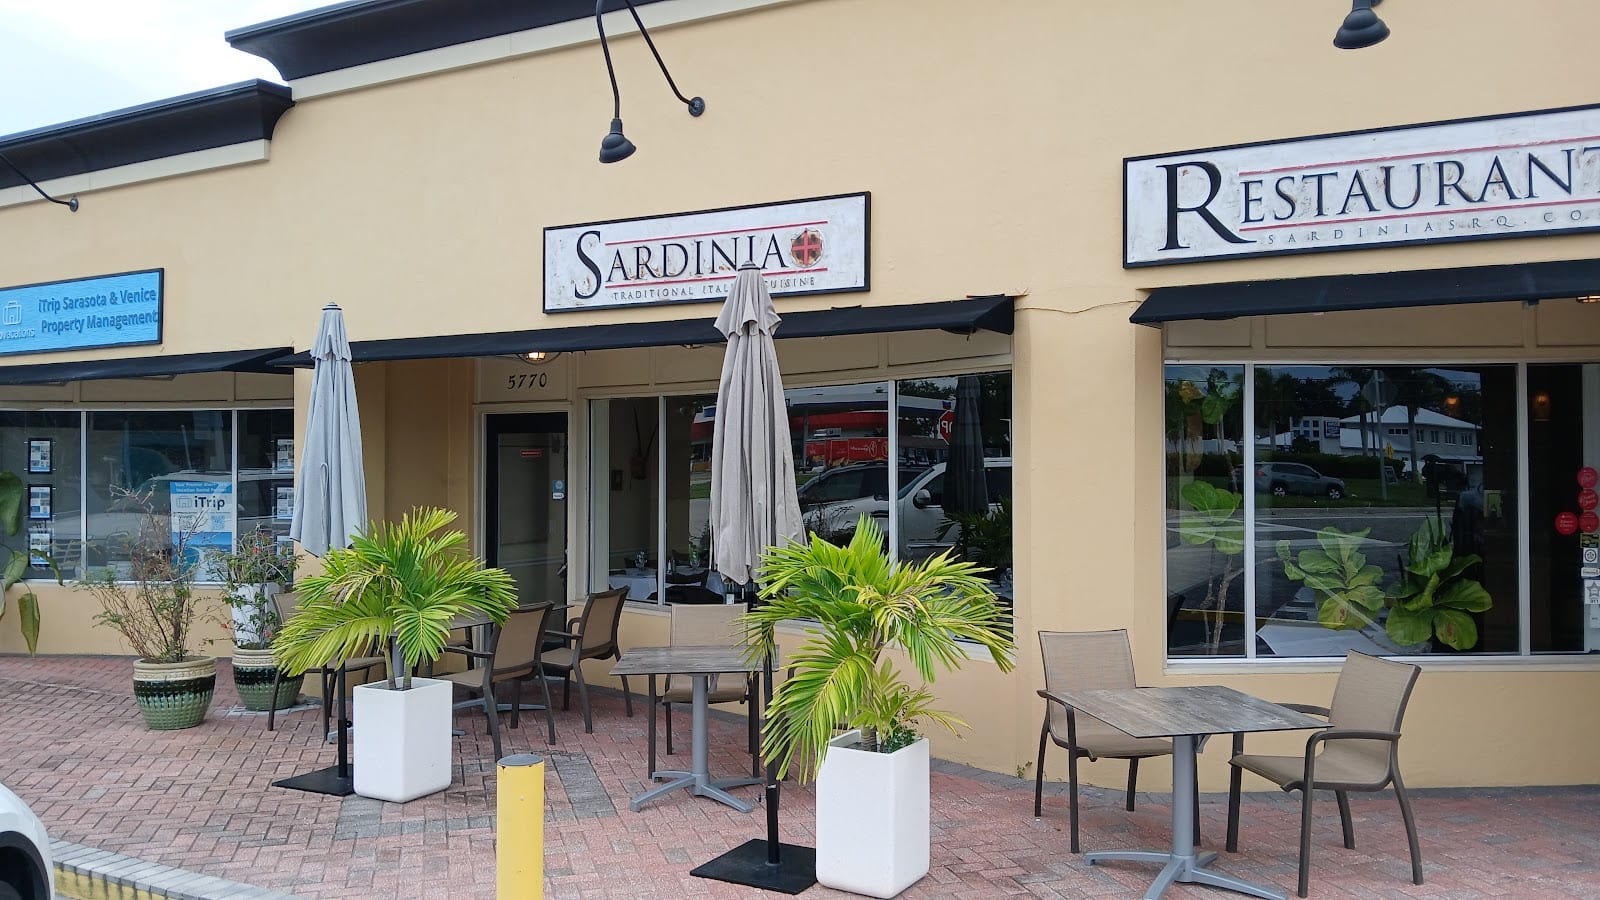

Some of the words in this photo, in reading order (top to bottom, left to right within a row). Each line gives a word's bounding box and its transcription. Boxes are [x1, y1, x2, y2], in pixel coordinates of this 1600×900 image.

[1268, 209, 1600, 245] SARDINIASRQ.CO
[574, 230, 790, 299] SARDINIA
[38, 297, 60, 314] iTrip
[63, 293, 107, 310] Sarasota
[109, 291, 119, 305] &
[120, 287, 156, 304] Venice
[613, 286, 694, 300] TRADITIONAL
[703, 282, 736, 295] ITAL
[41, 317, 85, 335] Property
[87, 309, 158, 330] Management
[507, 372, 547, 390] 5770
[194, 495, 225, 511] iTrip
